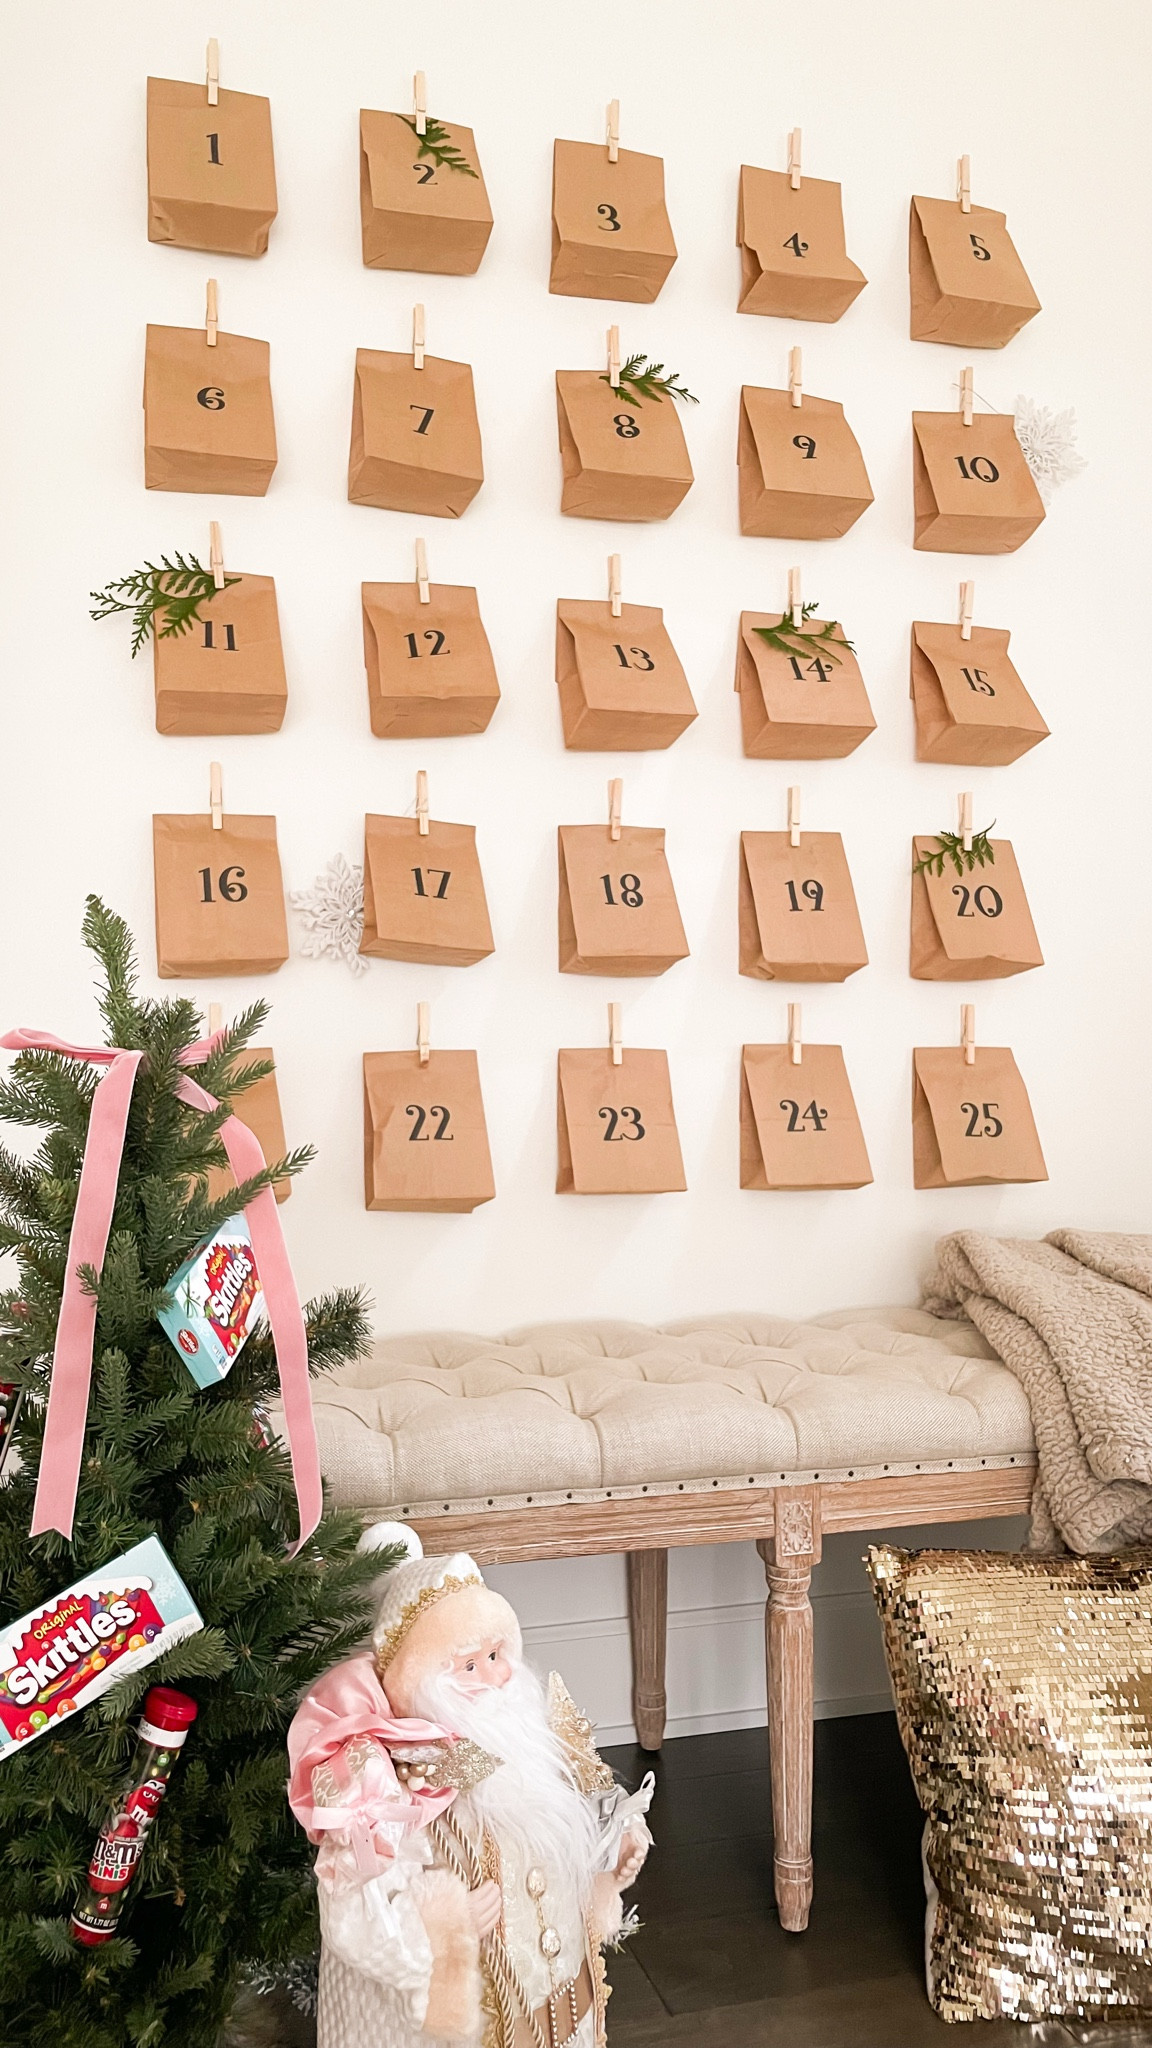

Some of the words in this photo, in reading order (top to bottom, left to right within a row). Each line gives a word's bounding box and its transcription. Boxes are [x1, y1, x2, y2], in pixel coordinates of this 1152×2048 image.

[206, 132, 224, 167] 1
[412, 162, 438, 185] 2
[597, 203, 621, 232] 3
[782, 231, 809, 259] 4
[968, 233, 992, 262] 5
[196, 386, 226, 411] 6
[409, 404, 435, 436] 7
[613, 414, 640, 440] 8
[792, 434, 818, 460] 9
[954, 455, 1000, 483] 10
[201, 620, 239, 652] 11
[403, 630, 450, 660] 12
[612, 643, 656, 672] 13
[786, 656, 834, 684] 14
[959, 667, 996, 698] 15
[197, 865, 249, 904] 16
[410, 866, 452, 901] 17
[600, 872, 645, 908] 18
[784, 878, 826, 913] 19
[951, 885, 1004, 919] 20
[405, 1104, 455, 1142] 22
[598, 1105, 646, 1142] 23
[779, 1099, 829, 1133] 24
[959, 1101, 1004, 1139] 25
[210, 1252, 253, 1327] Skittles
[147, 1629, 155, 1637] S
[7, 1600, 136, 1706] Skittles
[34, 1716, 42, 1724] S
[62, 1704, 69, 1712] S
[20, 1727, 28, 1736] S
